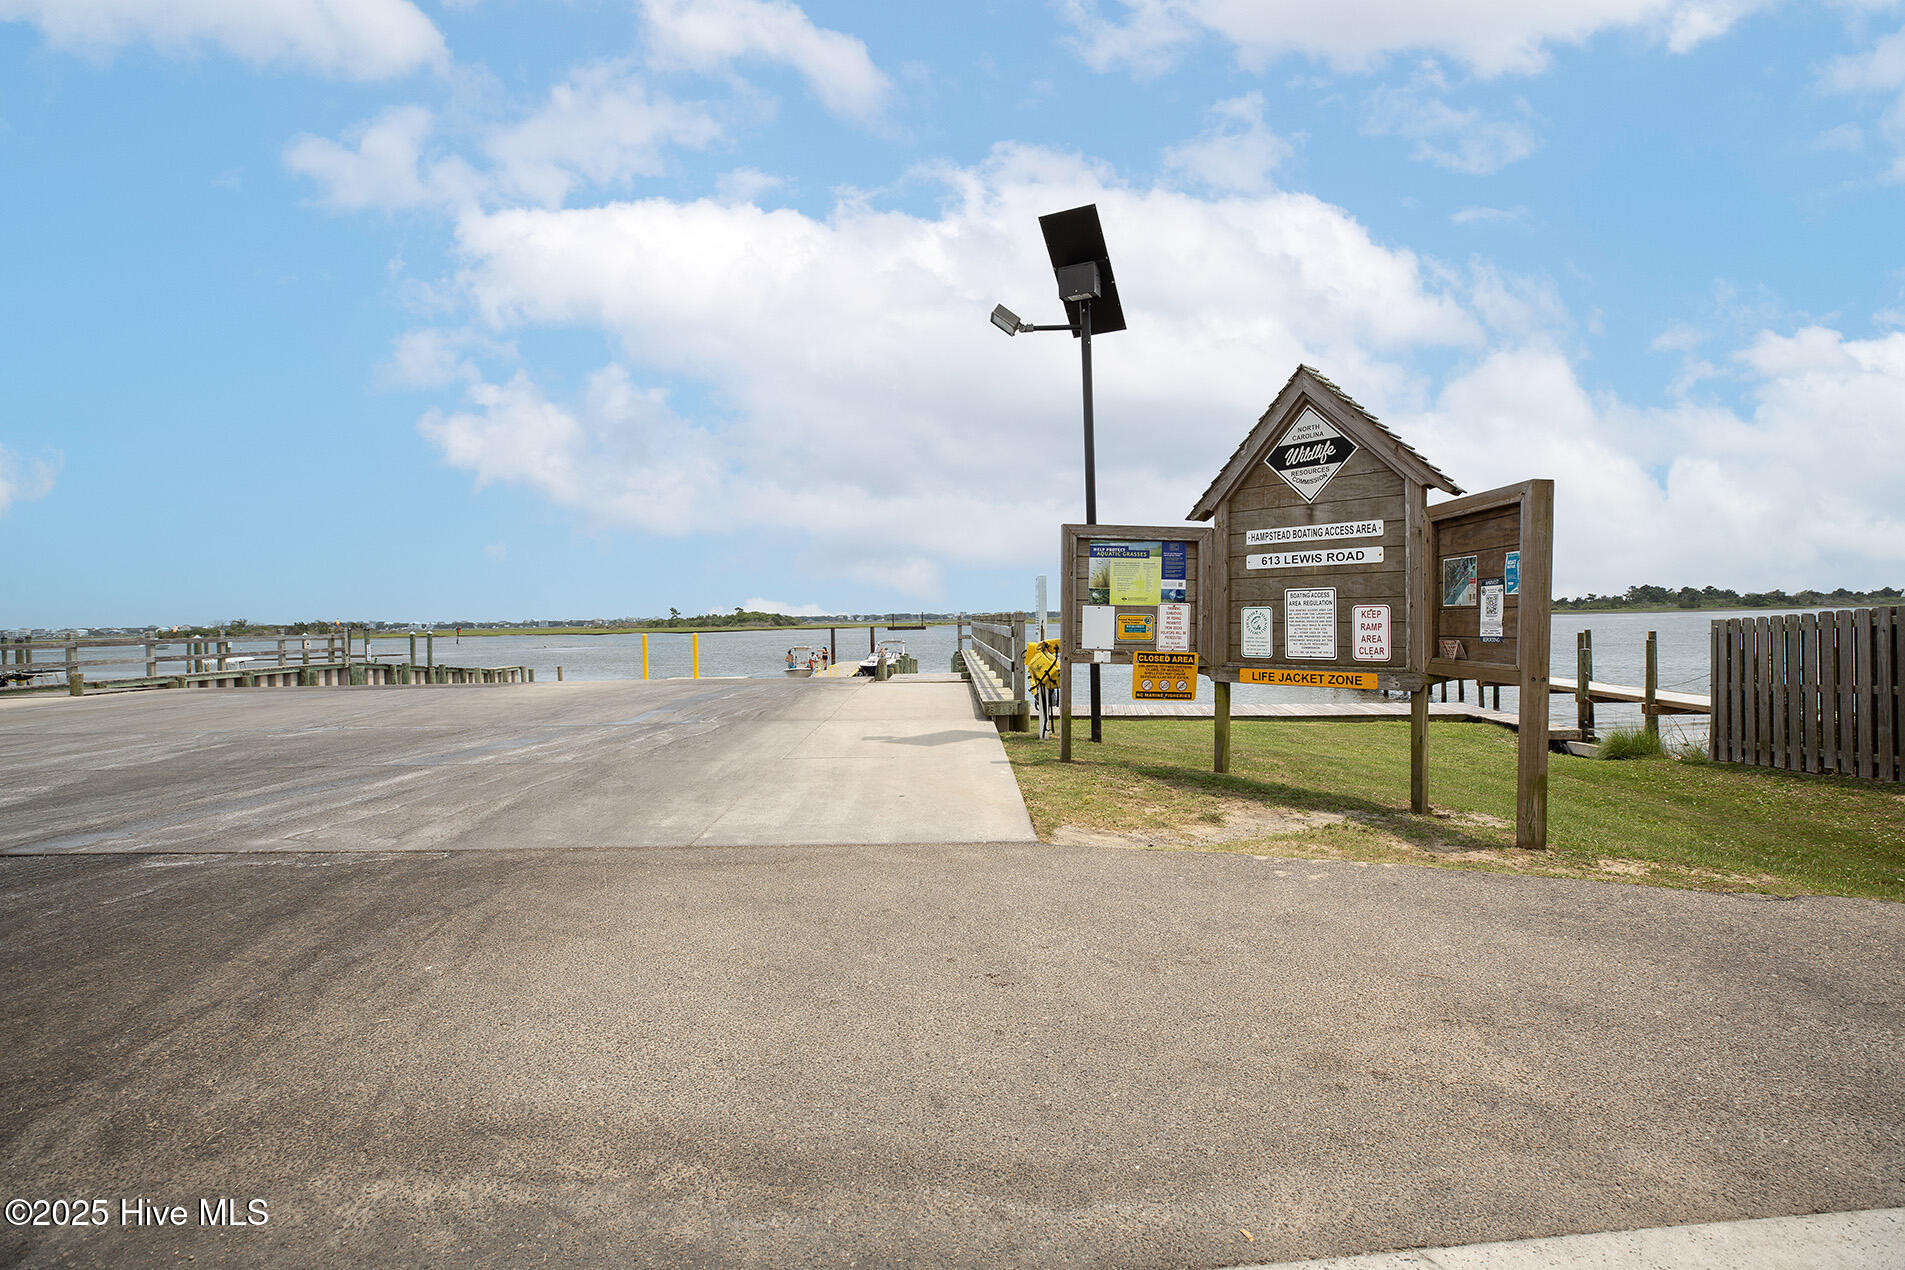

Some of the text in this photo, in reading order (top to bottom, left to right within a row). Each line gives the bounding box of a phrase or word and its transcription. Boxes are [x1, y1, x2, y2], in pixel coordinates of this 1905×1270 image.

[1297, 424, 1320, 433] NORTH
[1292, 431, 1324, 442] CAROLINA
[1284, 440, 1337, 466] Wildlife
[1290, 466, 1330, 477] RESOURCES
[1292, 472, 1328, 484] COMMISSION
[1250, 523, 1378, 542] HAMPSTEAD BOATING ACCESS AREA
[1261, 550, 1365, 566] 613 LEWIS ROAD
[1361, 610, 1382, 619] KEEP
[1360, 623, 1383, 631] RAMP
[1361, 635, 1383, 643] AREA
[1358, 646, 1385, 655] CLEAR
[1252, 672, 1363, 686] LIFE JACKET ZONE
